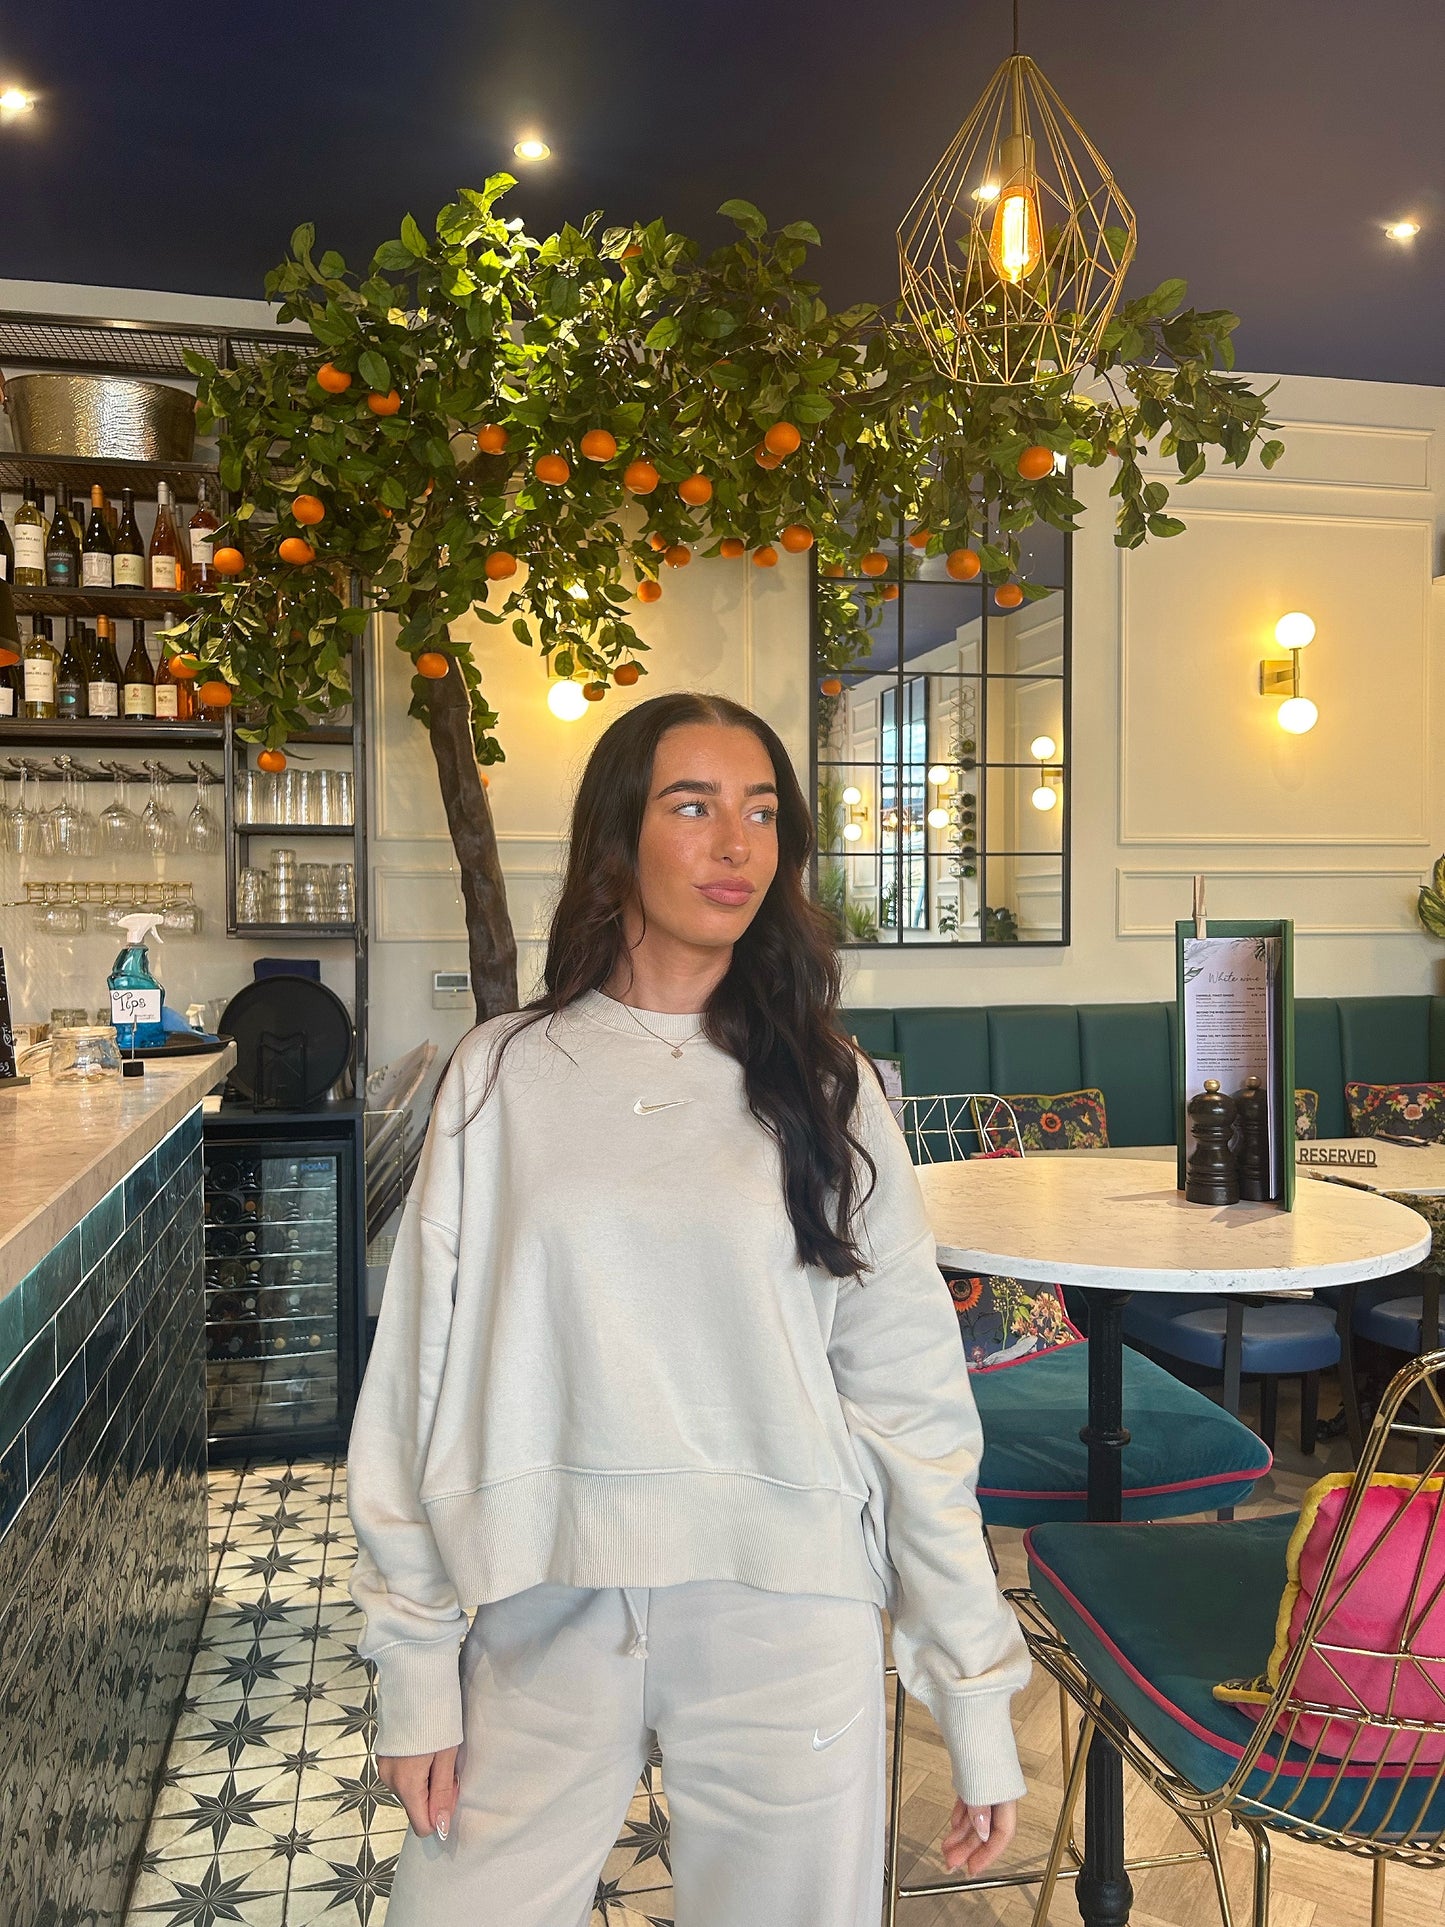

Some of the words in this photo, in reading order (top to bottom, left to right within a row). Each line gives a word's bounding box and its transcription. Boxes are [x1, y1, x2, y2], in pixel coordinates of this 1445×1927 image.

[1208, 971, 1238, 983] White
[112, 991, 146, 1017] Tips
[1300, 1147, 1376, 1164] RESERVED
